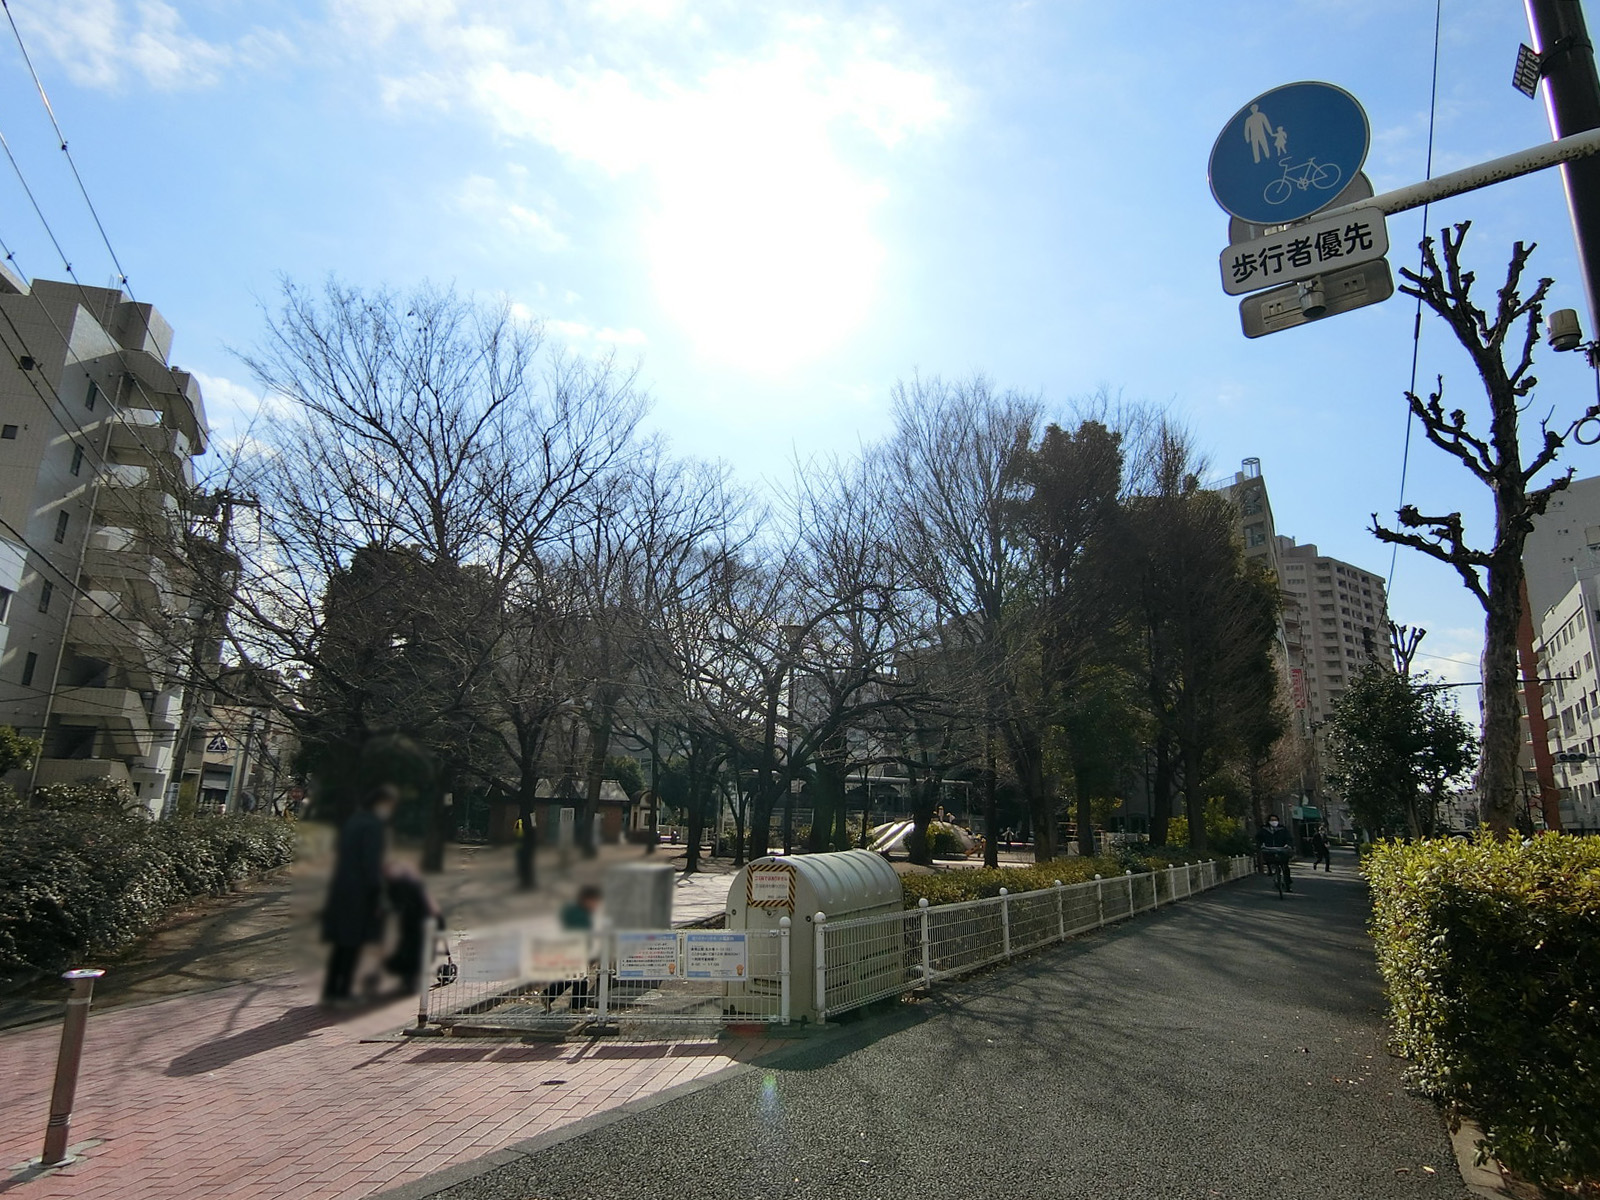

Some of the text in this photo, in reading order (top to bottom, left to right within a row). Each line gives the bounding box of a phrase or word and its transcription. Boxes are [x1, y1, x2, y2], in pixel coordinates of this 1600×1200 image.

[1231, 222, 1373, 284] 歩行者優先
